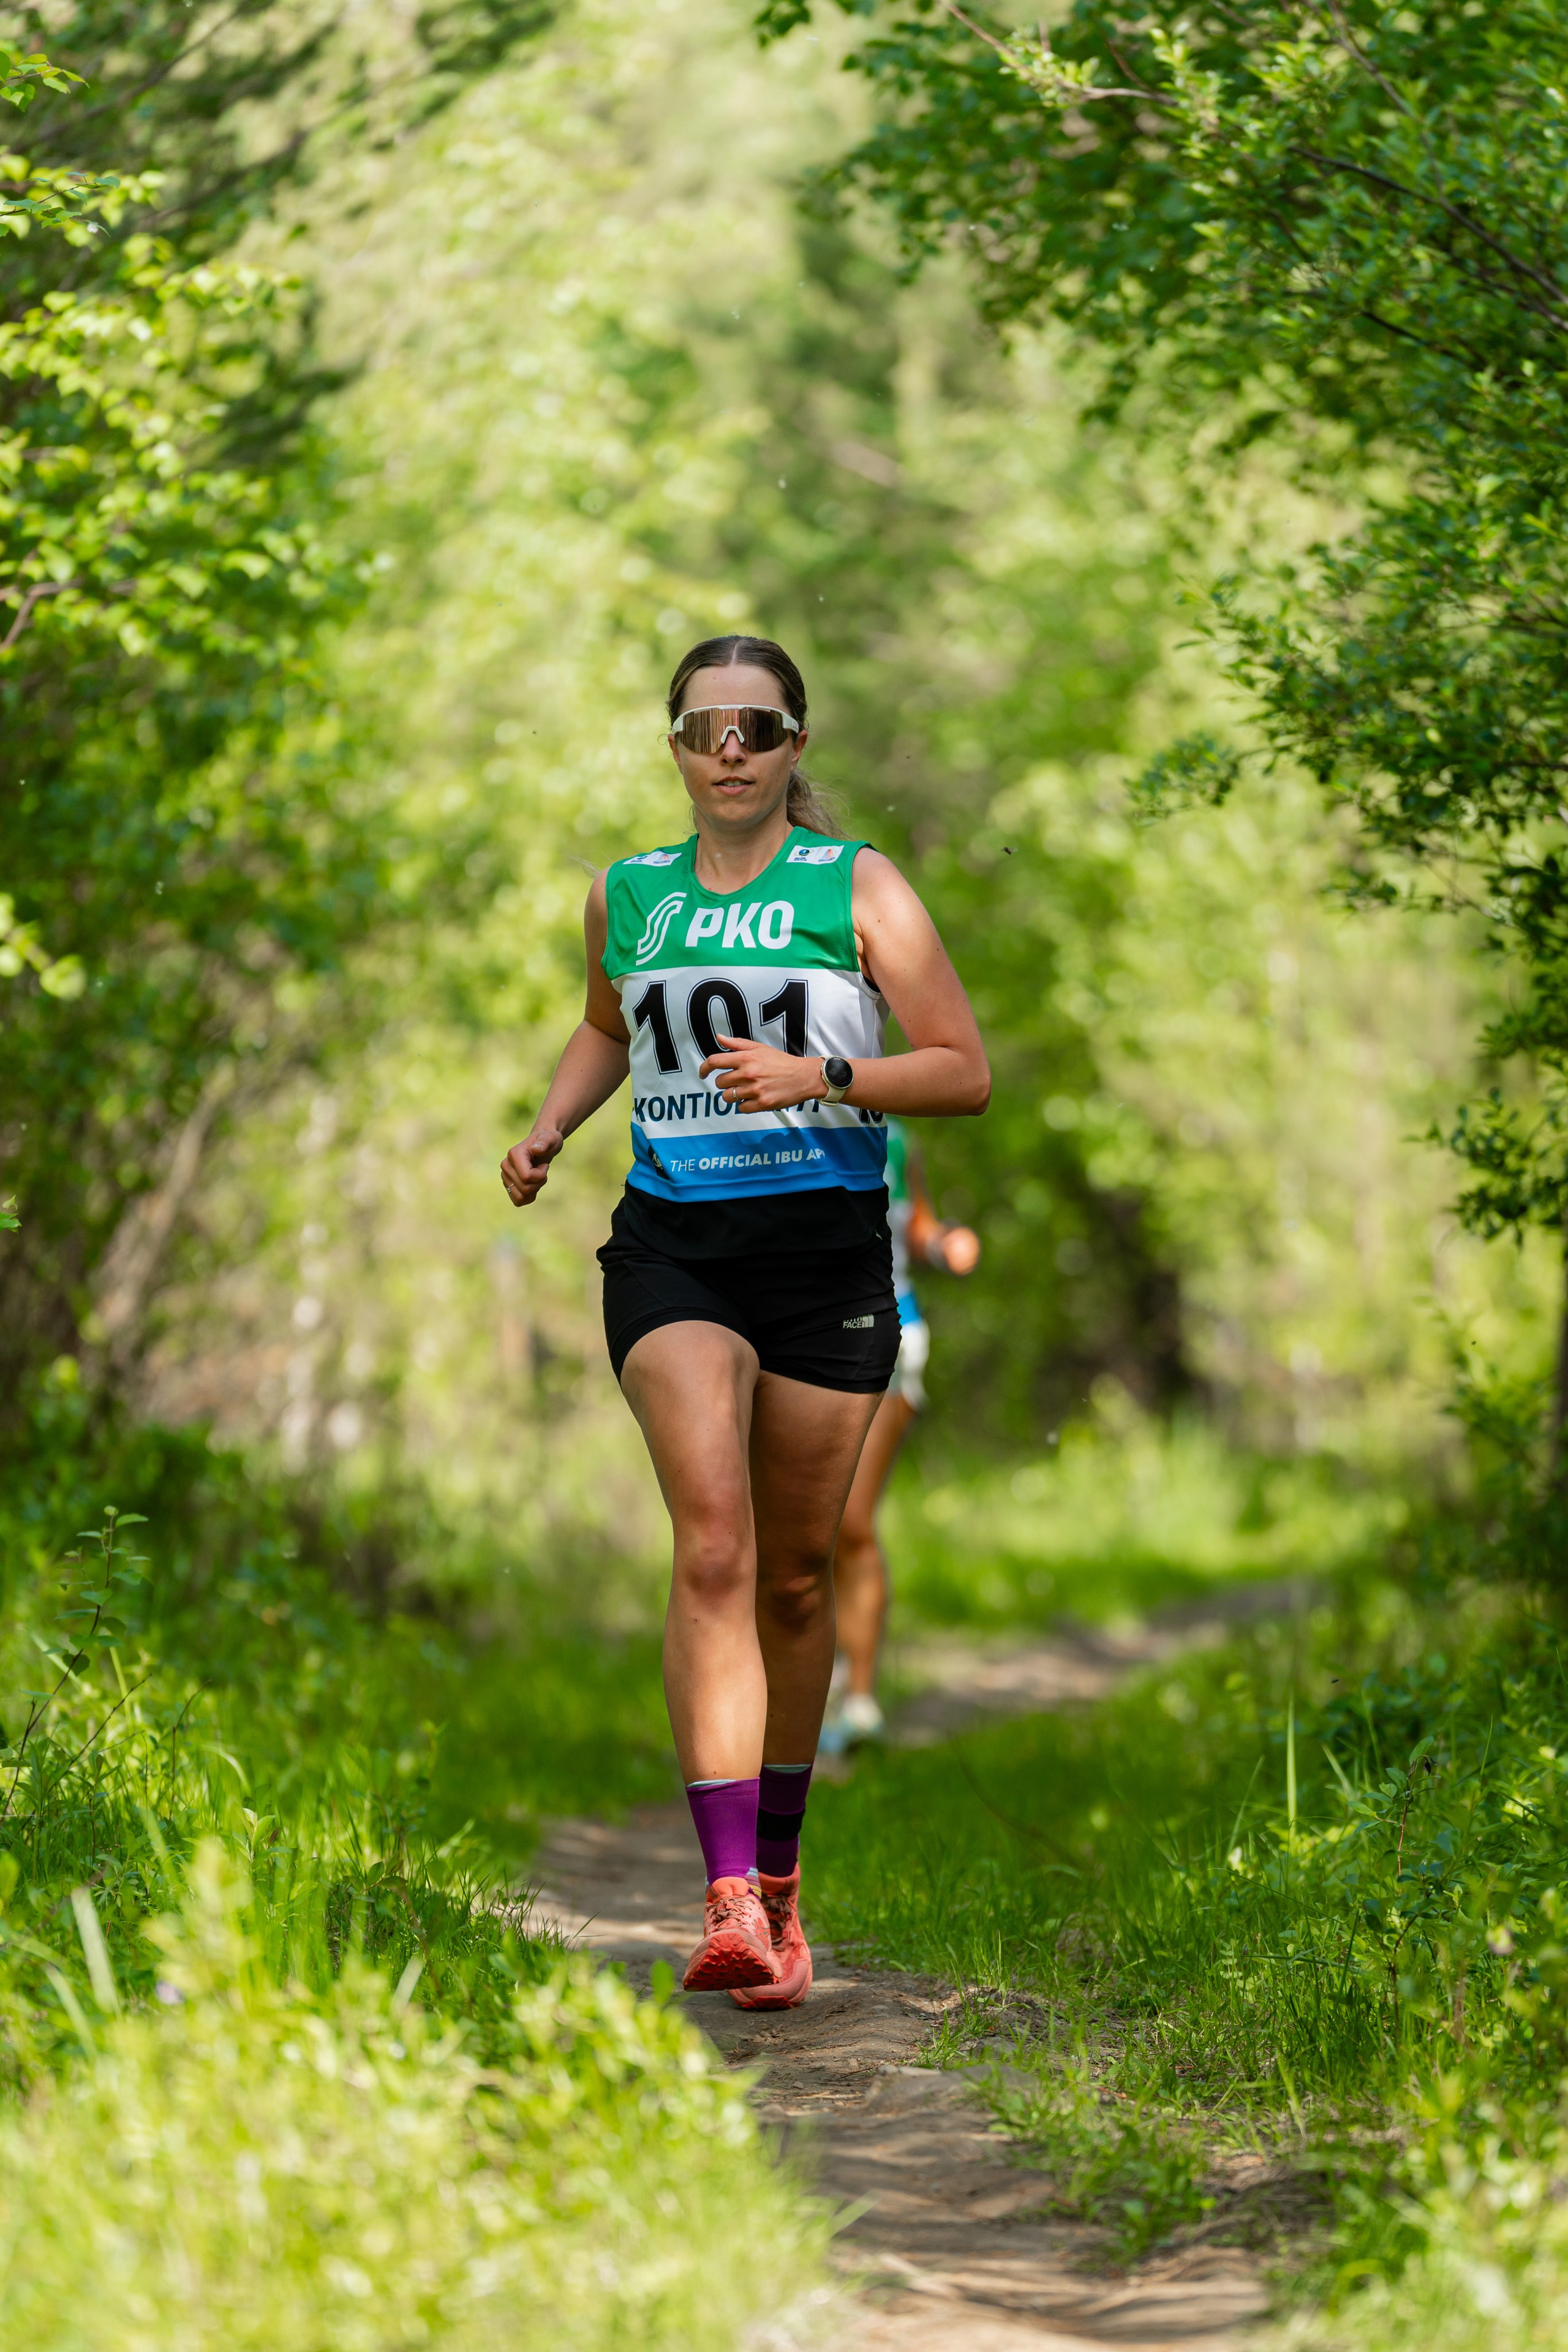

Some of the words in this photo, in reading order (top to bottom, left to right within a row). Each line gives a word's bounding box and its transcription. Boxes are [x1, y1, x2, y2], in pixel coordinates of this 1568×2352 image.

[685, 900, 794, 949] PKO
[633, 978, 809, 1074] 101
[635, 1091, 820, 1122] KONTIO
[671, 1159, 695, 1172] THE
[699, 1153, 771, 1170] OFFICIAL
[775, 1150, 802, 1164] IBU
